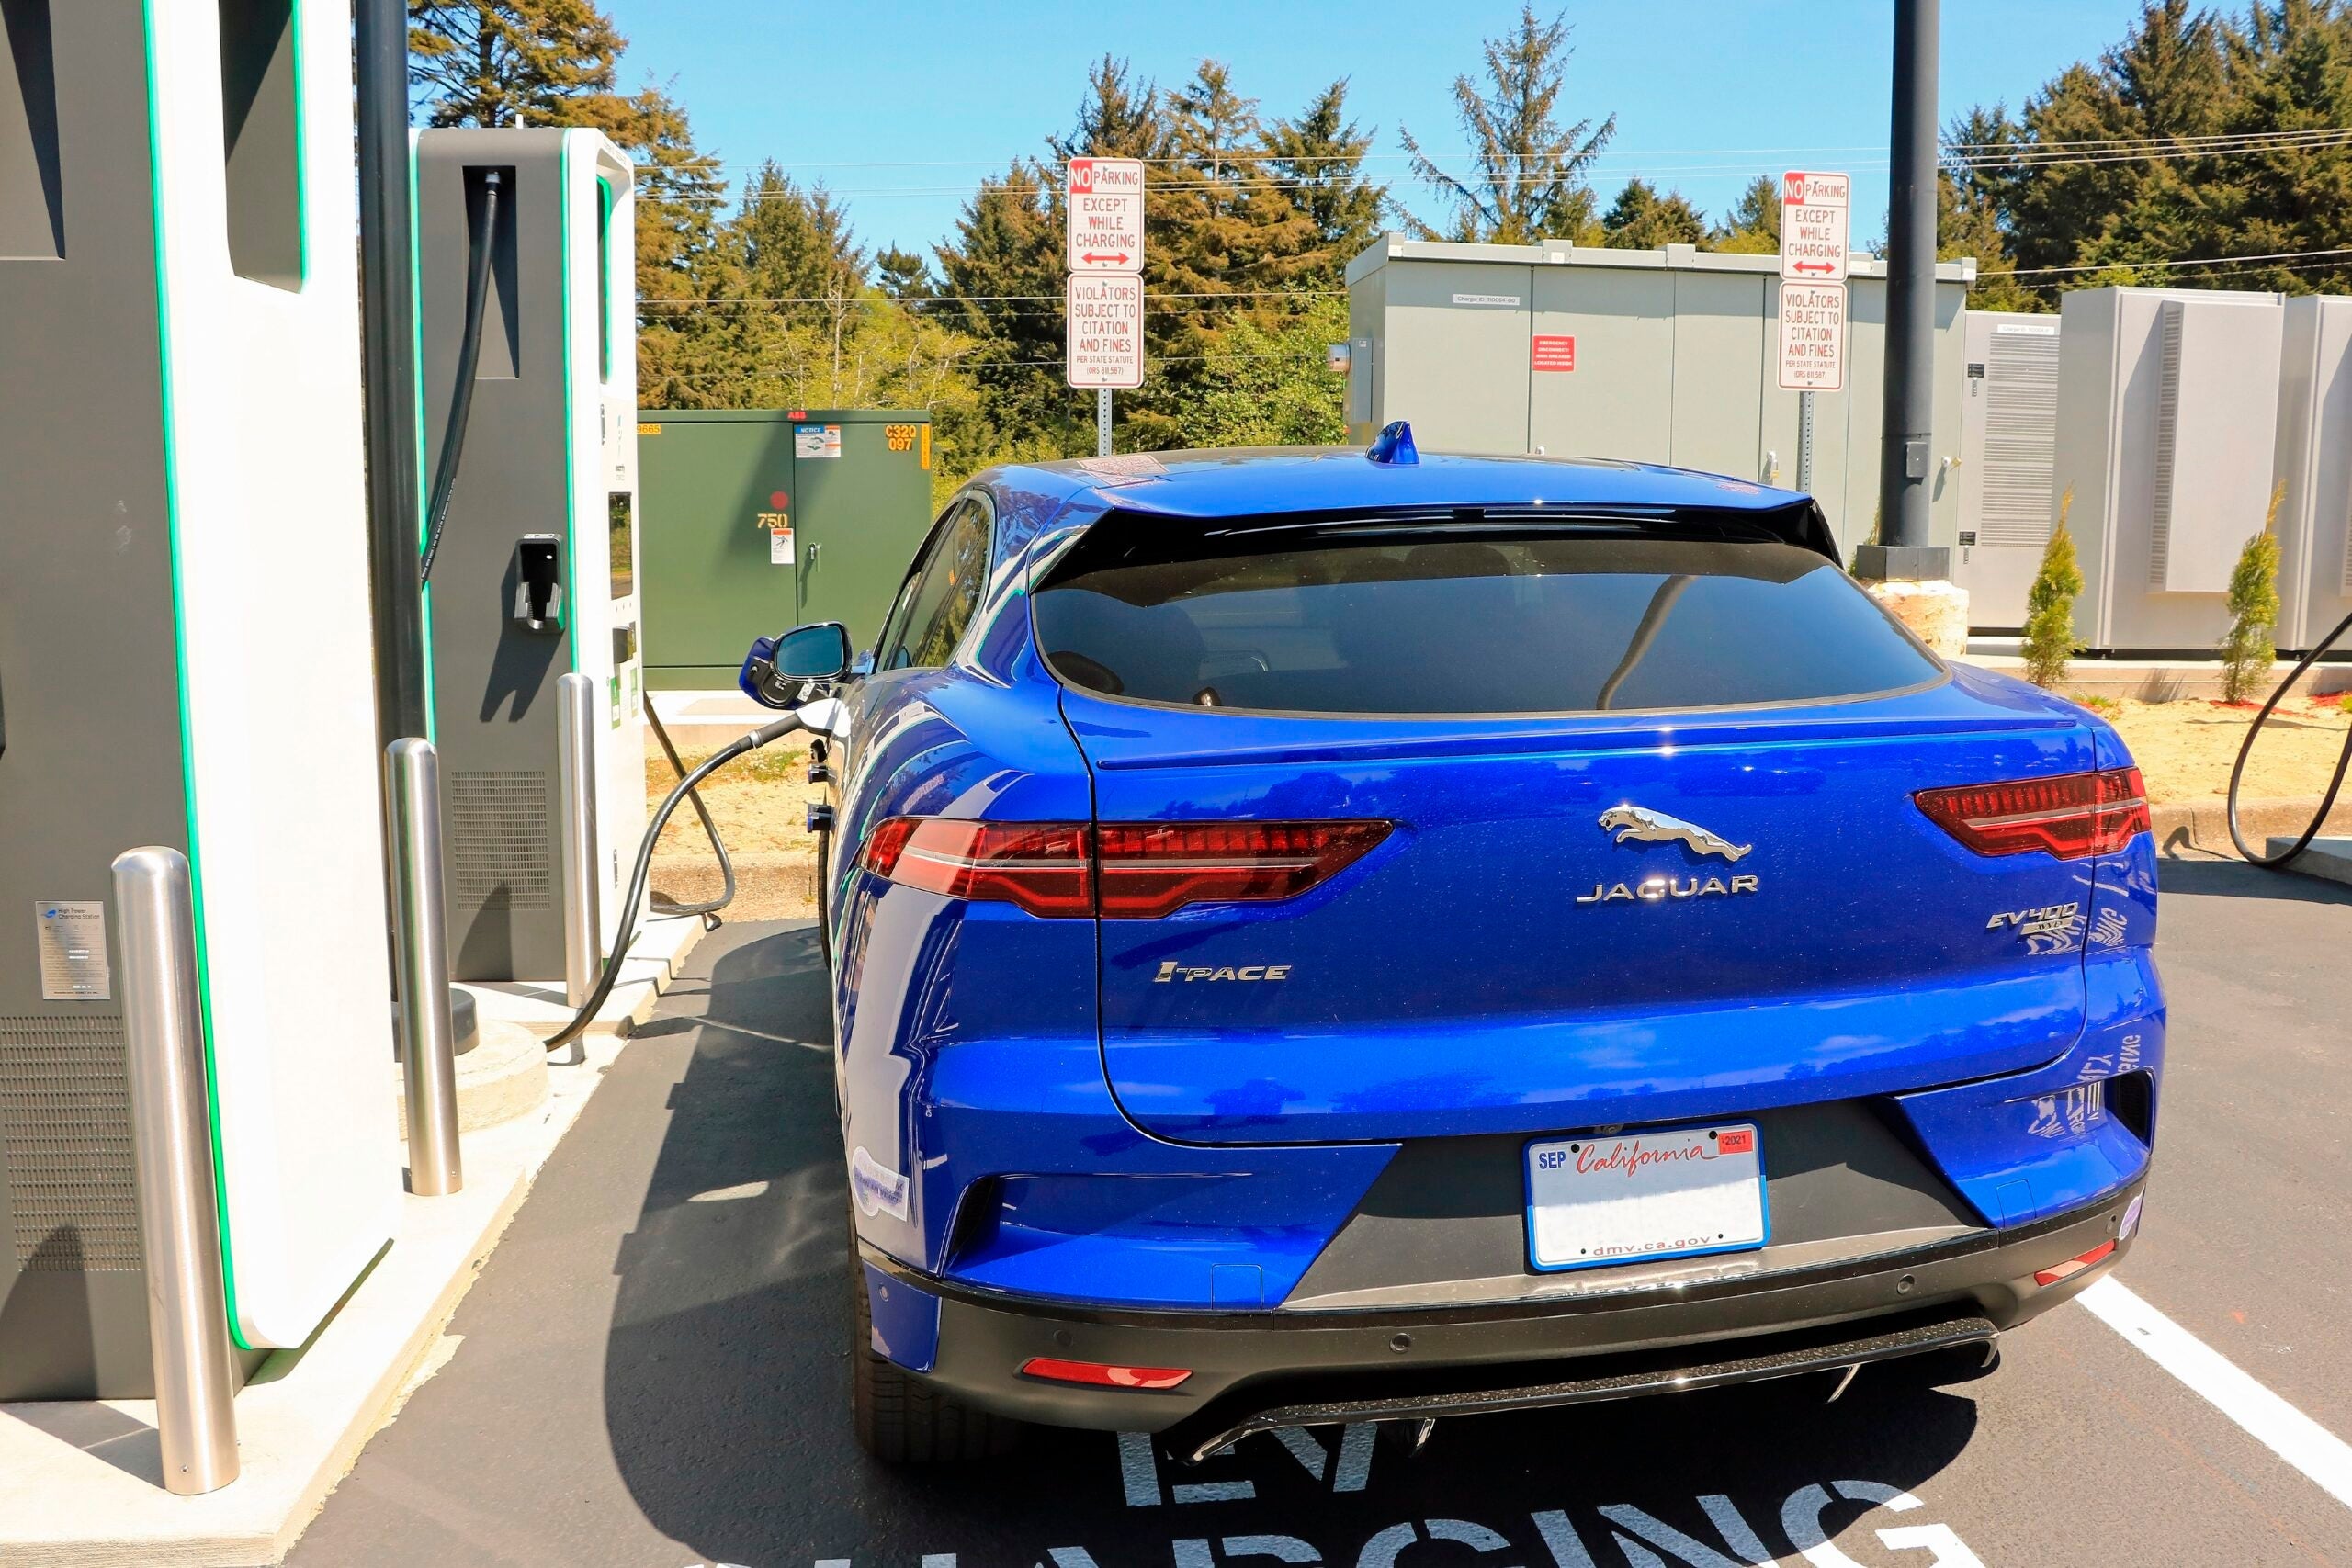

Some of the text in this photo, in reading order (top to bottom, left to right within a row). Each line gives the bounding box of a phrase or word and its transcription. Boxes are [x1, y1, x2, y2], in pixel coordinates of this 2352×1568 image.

[1071, 167, 1138, 187] NO PARKING
[1785, 179, 1846, 199] NO PARKING
[1083, 198, 1127, 212] EXCEPT
[1088, 217, 1123, 230] WHILE
[1795, 209, 1836, 224] EXCEPT
[1076, 233, 1136, 248] CHARGING
[1800, 226, 1830, 241] WHILE
[1788, 243, 1841, 258] CHARGING
[1075, 286, 1136, 301] VIOLATORS
[1785, 293, 1839, 309] VIOLATORS
[1075, 303, 1136, 318] SUBJECT TO
[1785, 310, 1839, 325] SUBJECT TO
[1081, 321, 1129, 335] CITATION
[1791, 326, 1833, 341] CITATION
[1080, 338, 1132, 353] AND FINES
[1788, 343, 1835, 358] AND FINES
[1076, 355, 1134, 365] PER STATE STATUTE
[1785, 359, 1836, 369] PER STATE STATUTE
[888, 437, 912, 451] 097
[757, 513, 788, 529] 750
[1576, 874, 1758, 903] JAGUAR
[1539, 1134, 1747, 1178] SEP California 2021
[1592, 1235, 1711, 1257] dmv.ca.gov
